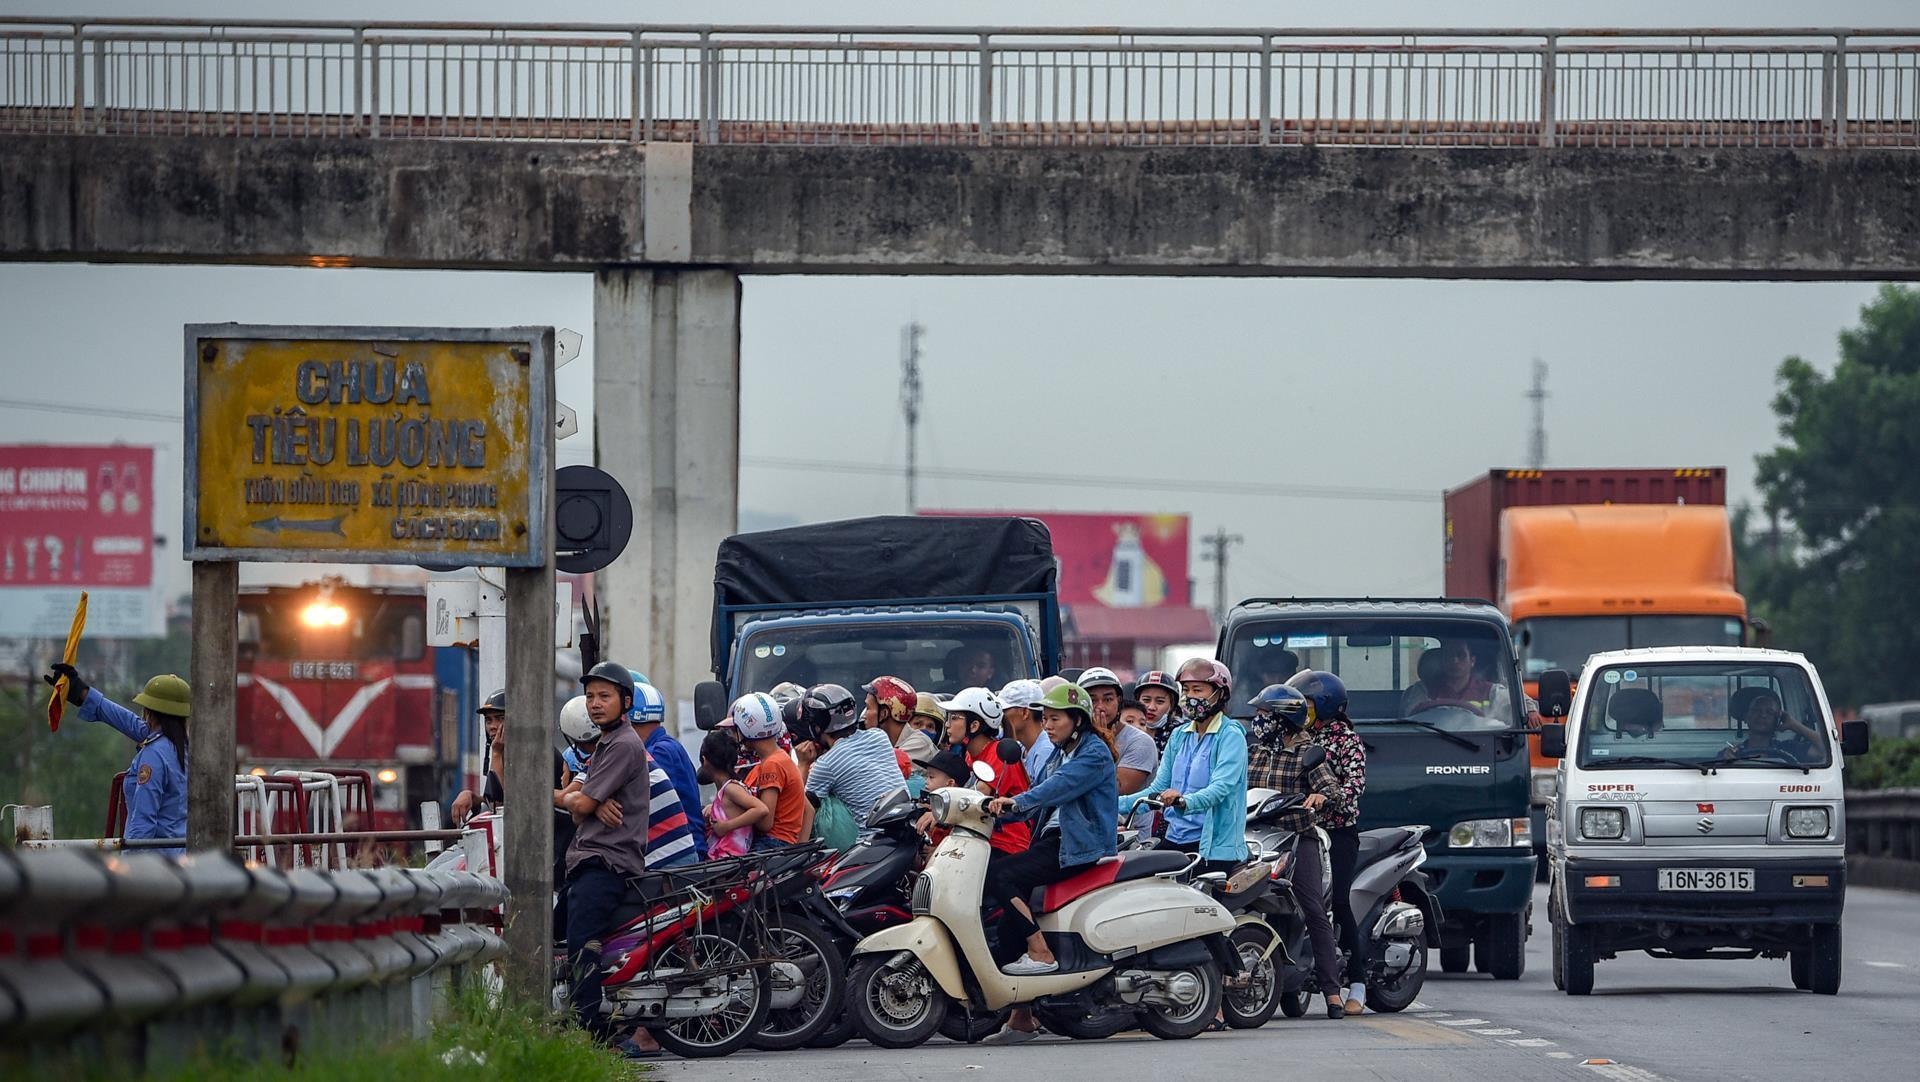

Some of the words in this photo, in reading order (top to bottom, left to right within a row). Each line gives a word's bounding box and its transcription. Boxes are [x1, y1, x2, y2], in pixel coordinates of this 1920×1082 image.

[296, 343, 431, 405] CHÙA
[346, 412, 486, 468] LƯƠNG
[1426, 766, 1490, 775] FRONTIER
[1588, 784, 1635, 792] SUPER
[1780, 784, 1812, 793] EURO
[1587, 792, 1649, 801] CARRY
[1666, 871, 1749, 890] 16N-3615
